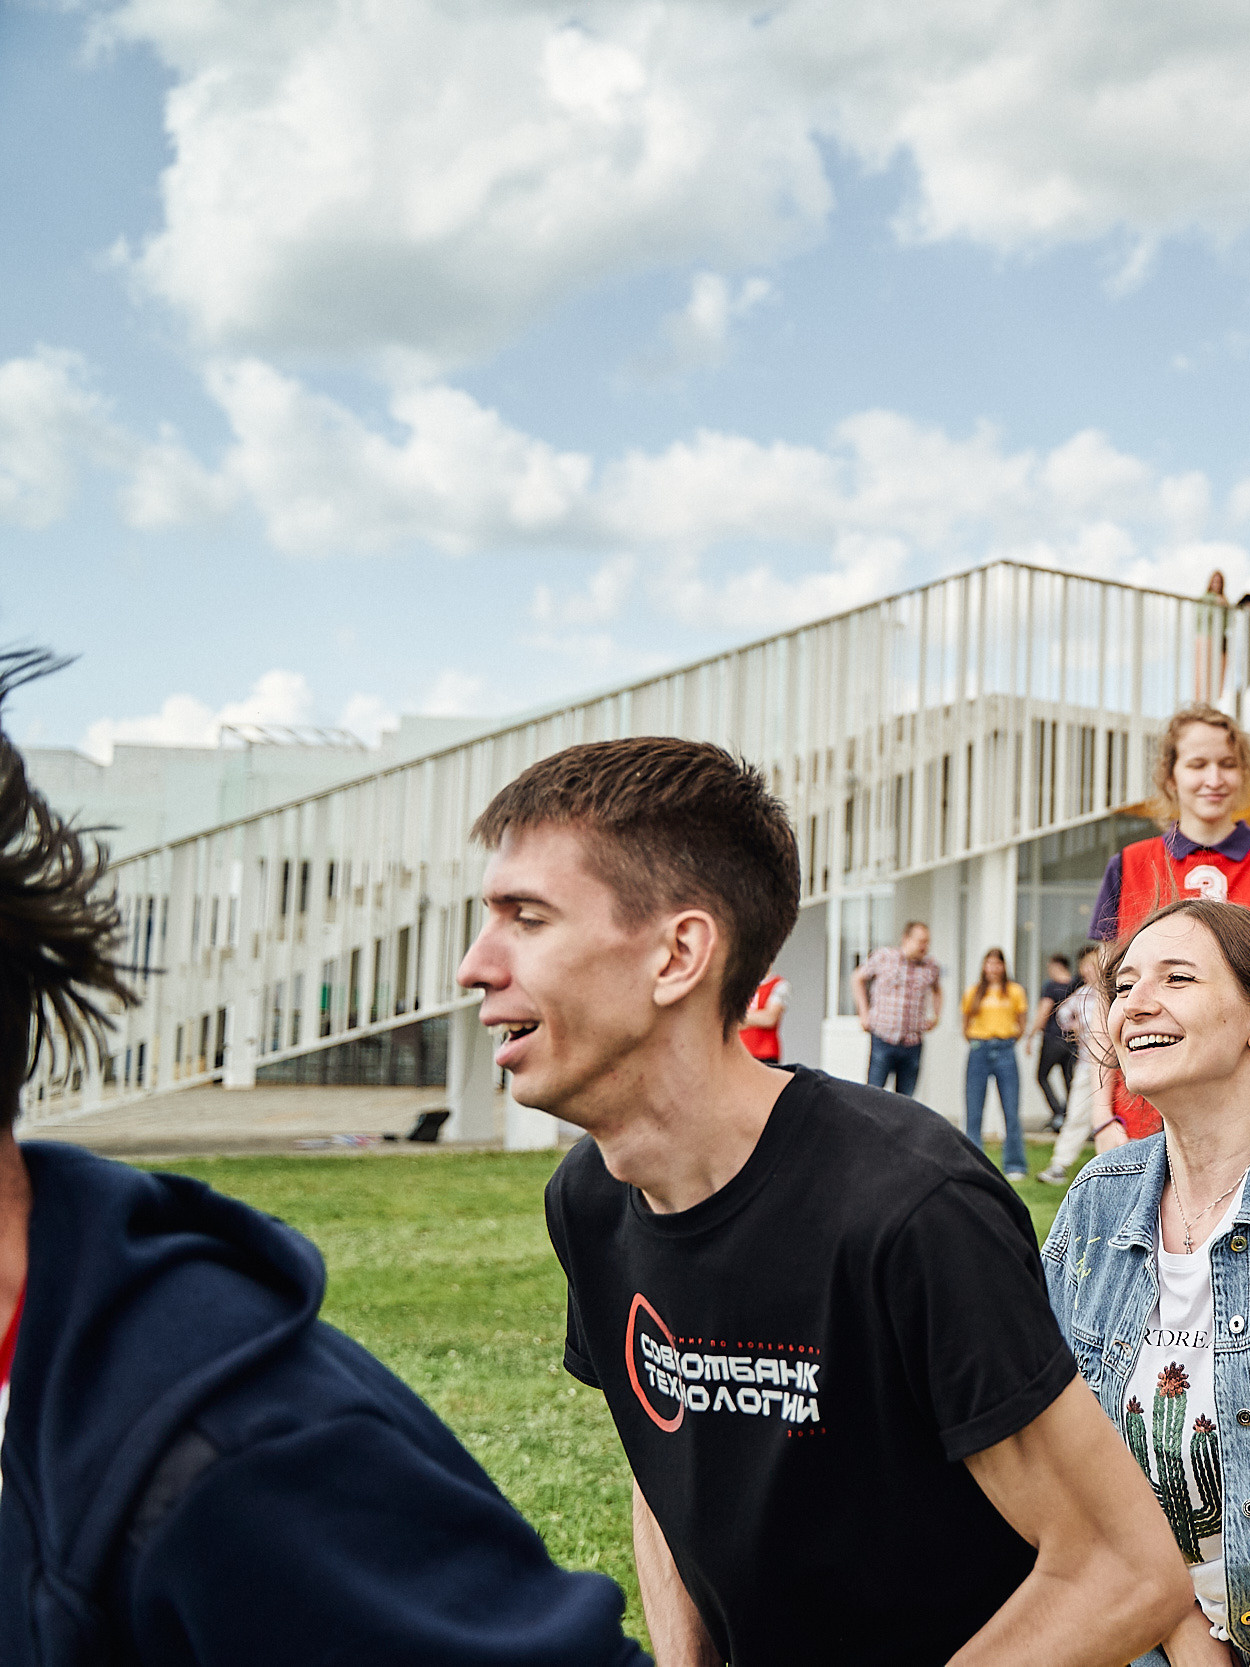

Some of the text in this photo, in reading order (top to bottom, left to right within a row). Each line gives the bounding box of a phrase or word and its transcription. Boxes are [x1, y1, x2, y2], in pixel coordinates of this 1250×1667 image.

[640, 1332, 821, 1394] СОВКОМБАНК
[673, 1336, 703, 1345] НИР
[644, 1360, 821, 1424] ТЕХНОЛОГИИ
